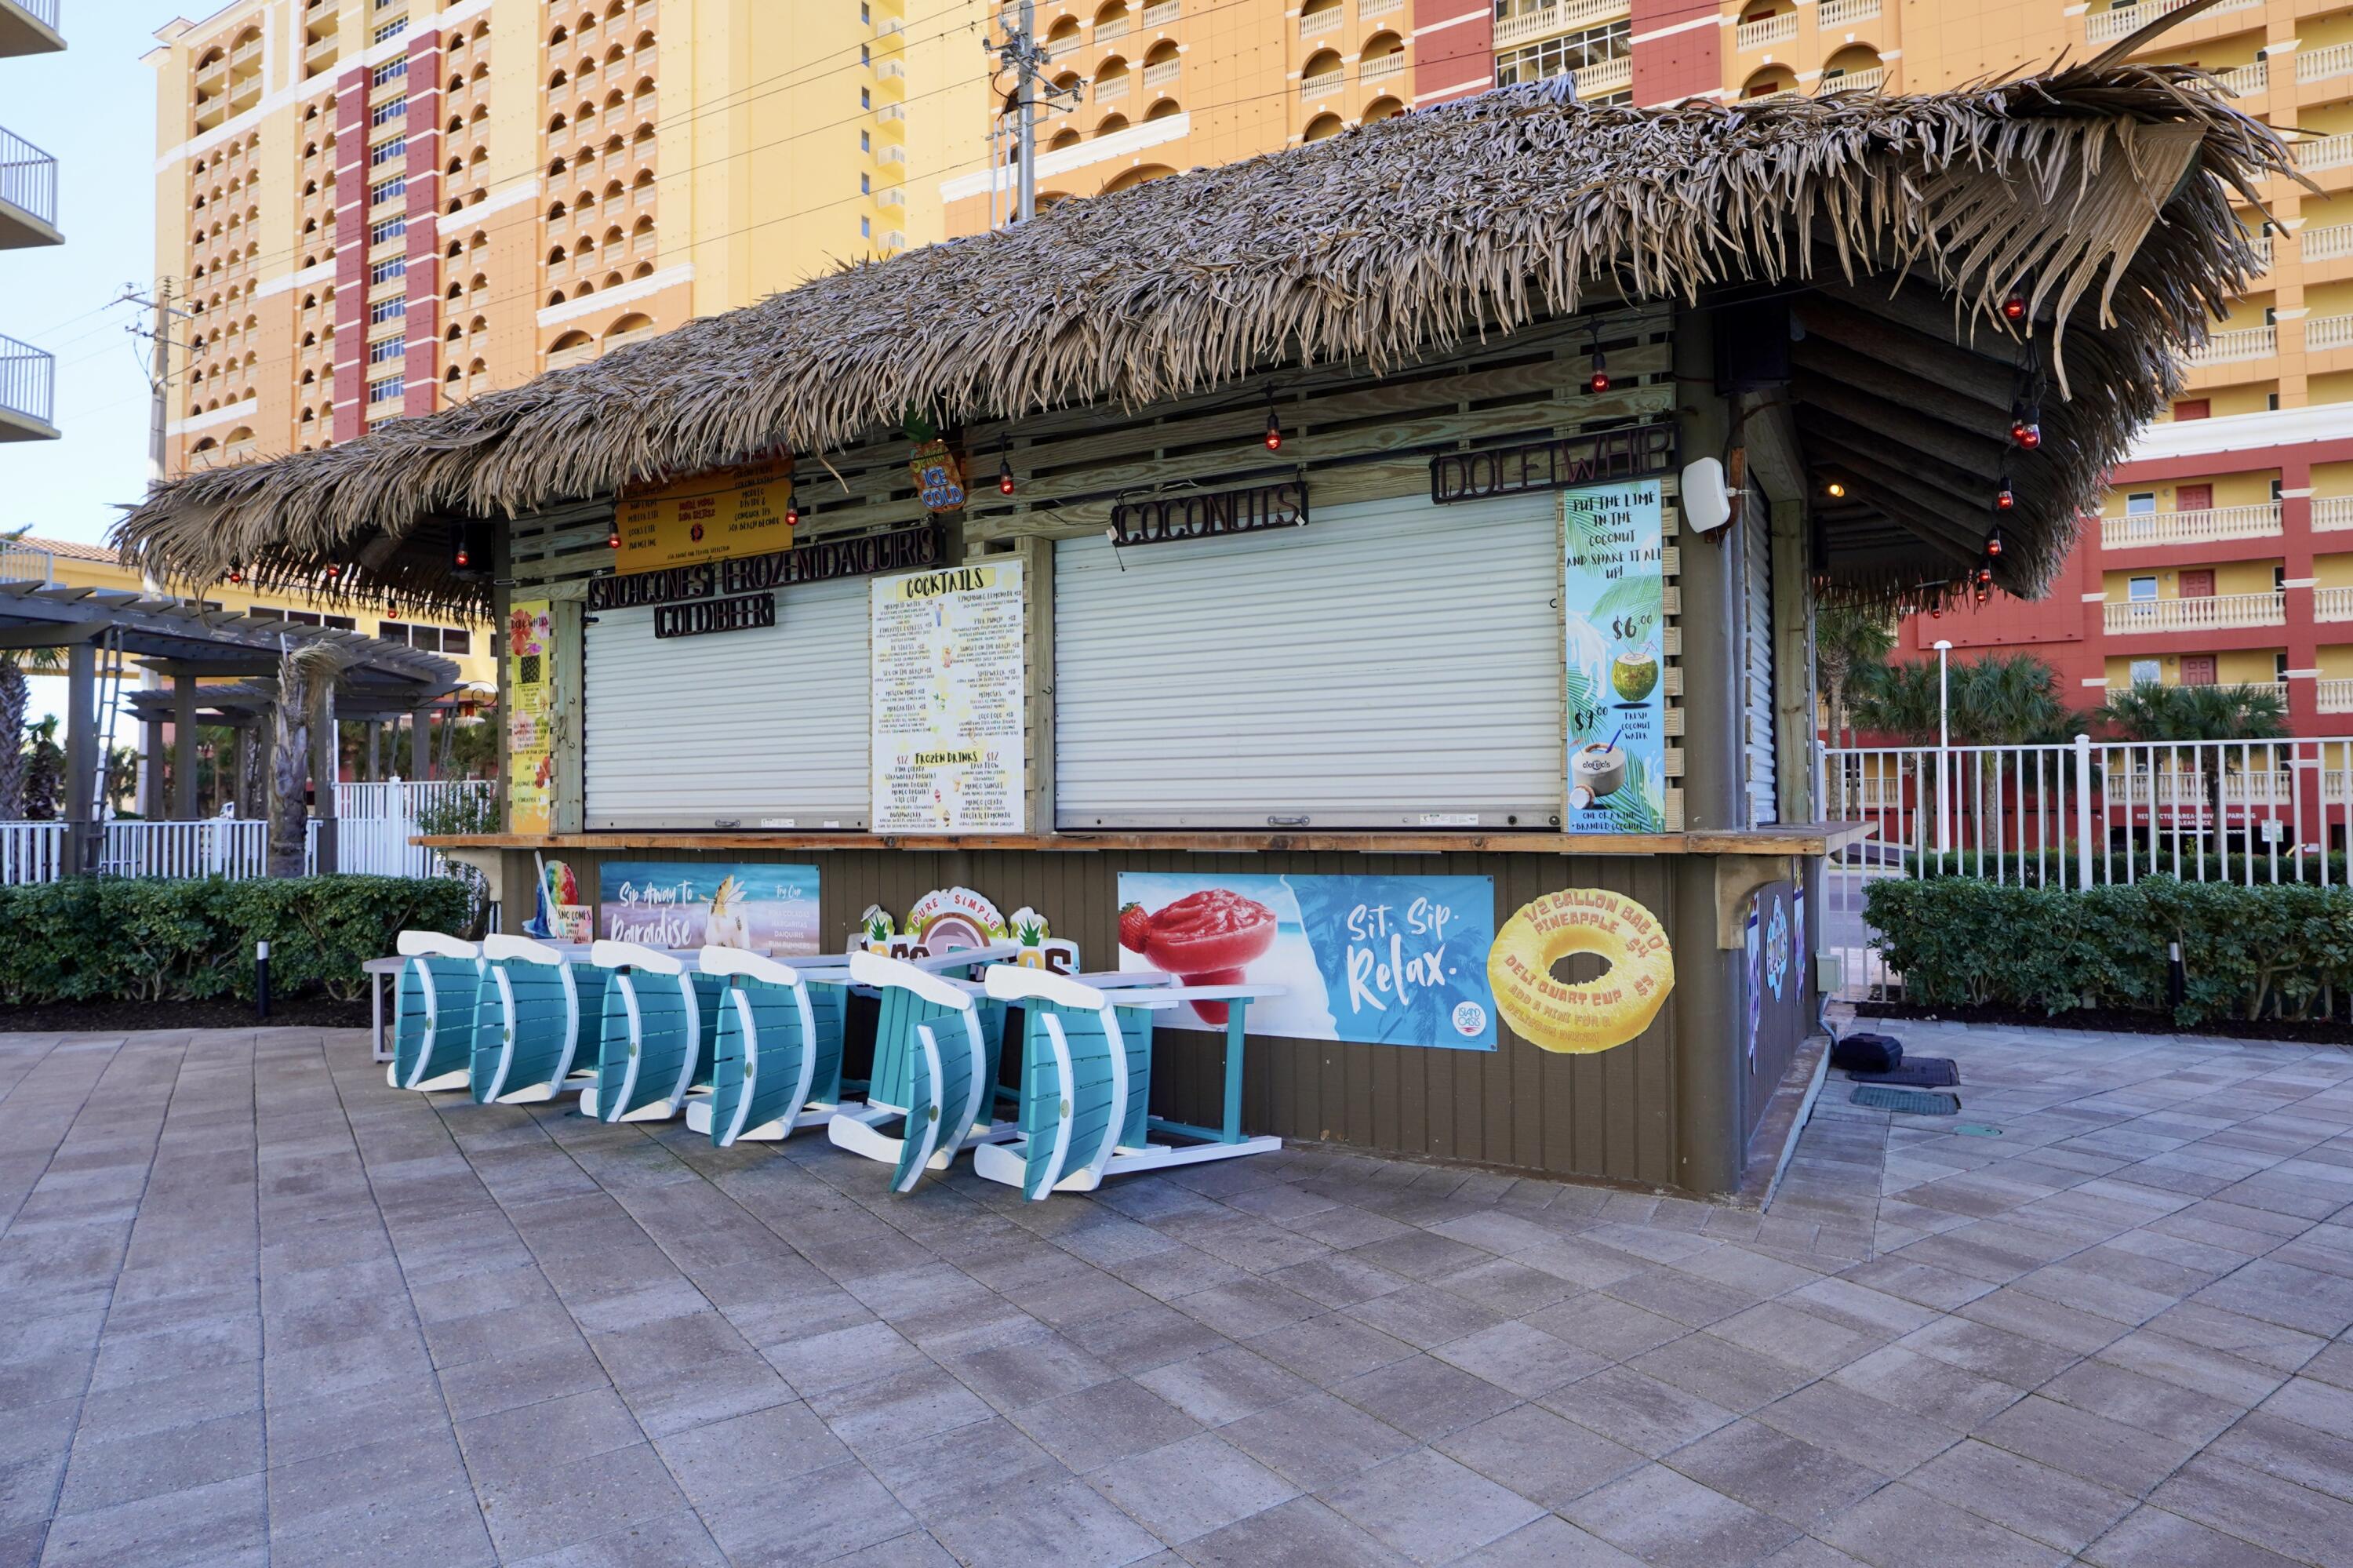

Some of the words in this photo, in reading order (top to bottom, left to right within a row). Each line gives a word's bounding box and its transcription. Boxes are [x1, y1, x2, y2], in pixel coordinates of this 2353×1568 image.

[1440, 446, 1540, 500] DOLE
[1569, 428, 1669, 483] WHIP
[922, 466, 948, 487] ICE
[922, 485, 966, 508] COLD
[1573, 497, 1594, 511] PUT
[1600, 495, 1620, 510] THE
[1624, 491, 1655, 508] LIME
[1119, 484, 1299, 544] COCONUTS
[1593, 515, 1606, 526] IN
[1610, 511, 1632, 526] THE
[1589, 529, 1636, 547] COCONUT
[725, 548, 811, 594] FROZEN
[820, 527, 936, 588] DAIQUIRIS
[1566, 555, 1587, 567] AND
[1591, 551, 1625, 566] SHAKE
[1630, 549, 1641, 562] IT
[1644, 548, 1662, 561] ALL
[907, 568, 984, 598] COCKTAILS
[1606, 565, 1624, 579] UP!
[656, 604, 709, 638] COLD
[714, 596, 766, 632] BEER
[1621, 721, 1650, 730] COCONUT
[1624, 711, 1648, 720] FRESH
[915, 752, 945, 765] FROZEN
[947, 751, 978, 763] DRINKS
[619, 881, 639, 910] Sip
[643, 882, 678, 909] Away
[775, 884, 787, 900] Try
[788, 884, 802, 898] Our
[558, 910, 570, 919] SNO
[572, 910, 591, 922] CONES
[912, 897, 939, 926] PURE
[954, 893, 998, 930] SIMPLE
[1522, 899, 1551, 923] 1/2
[1551, 891, 1619, 914] GALLON
[1620, 904, 1652, 935] BAG
[610, 907, 693, 948] Paradise
[774, 930, 804, 939] DAIQUIRIS
[1533, 911, 1620, 936] PINEAPPLE
[1347, 933, 1457, 1015] Relax.
[1504, 954, 1537, 987] DELI
[1537, 979, 1587, 1005] QUART
[1591, 987, 1622, 1006] CUP
[1458, 1006, 1481, 1017] ISLAND
[1507, 984, 1532, 1005] ADD
[1532, 999, 1541, 1012] A
[1574, 1014, 1598, 1027] FOR
[1457, 1017, 1481, 1027] OASIS
